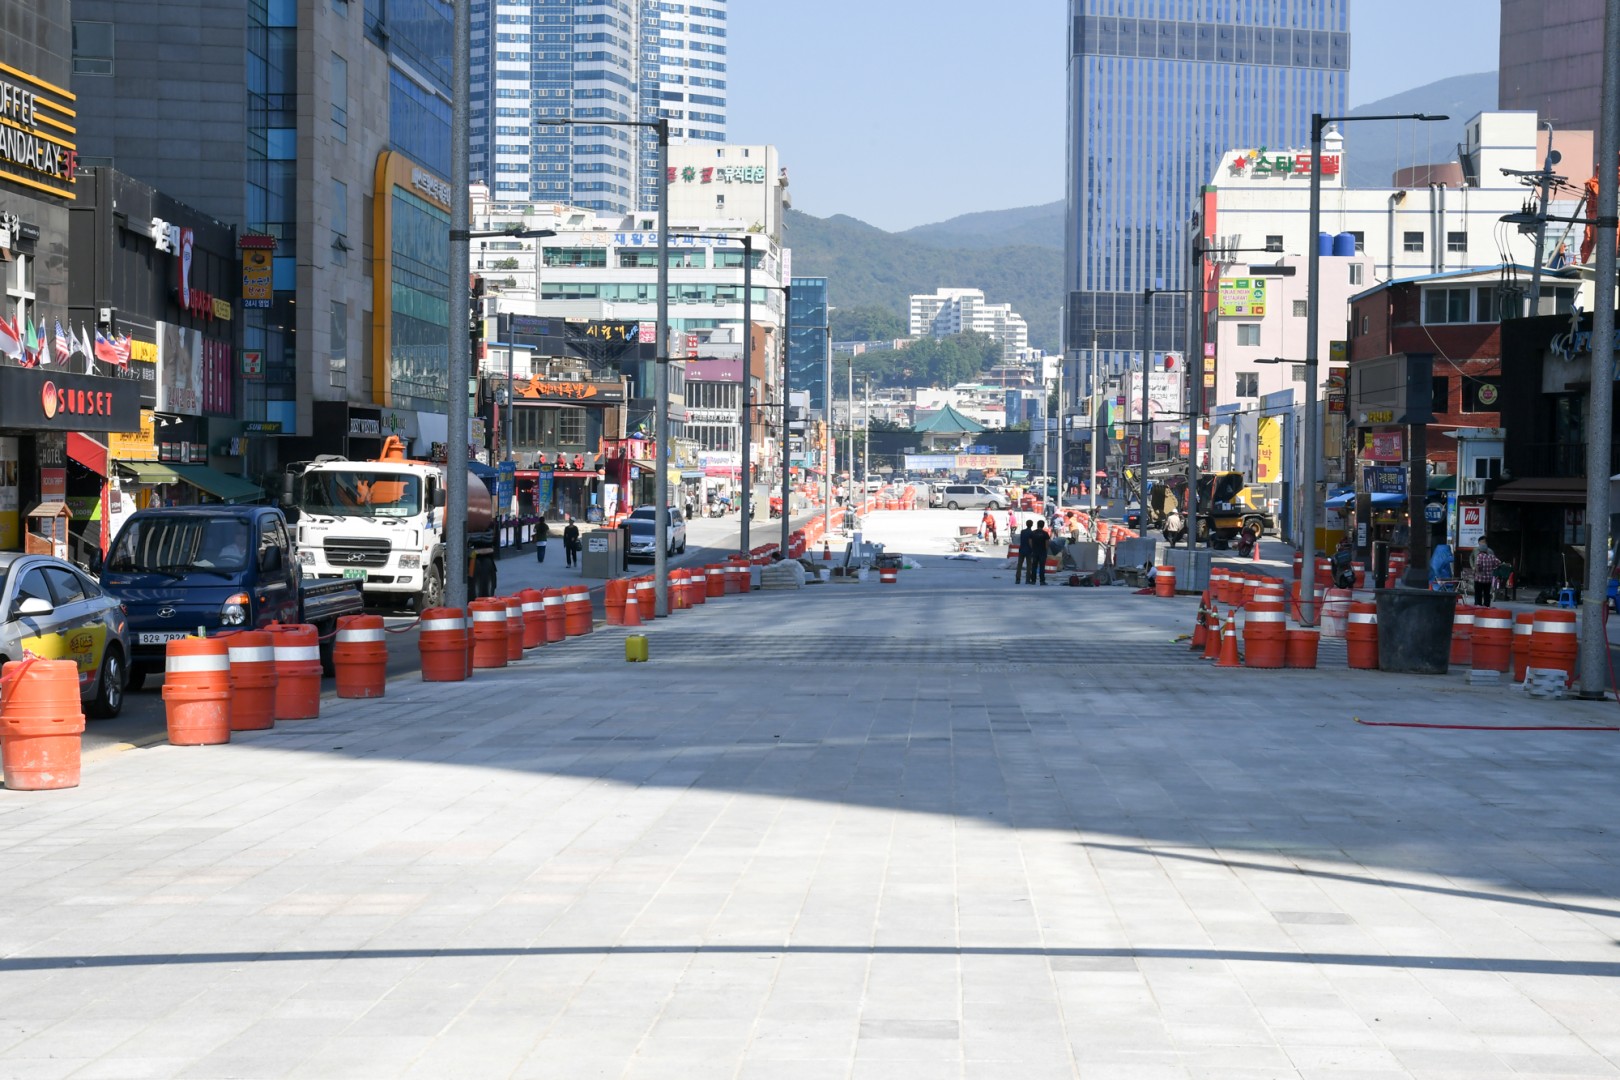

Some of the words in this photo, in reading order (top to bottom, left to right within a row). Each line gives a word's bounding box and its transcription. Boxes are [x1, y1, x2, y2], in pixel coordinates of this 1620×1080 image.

[57, 388, 113, 417] SUNSET
[42, 448, 62, 464] HOTEL
[1465, 510, 1479, 523] illy
